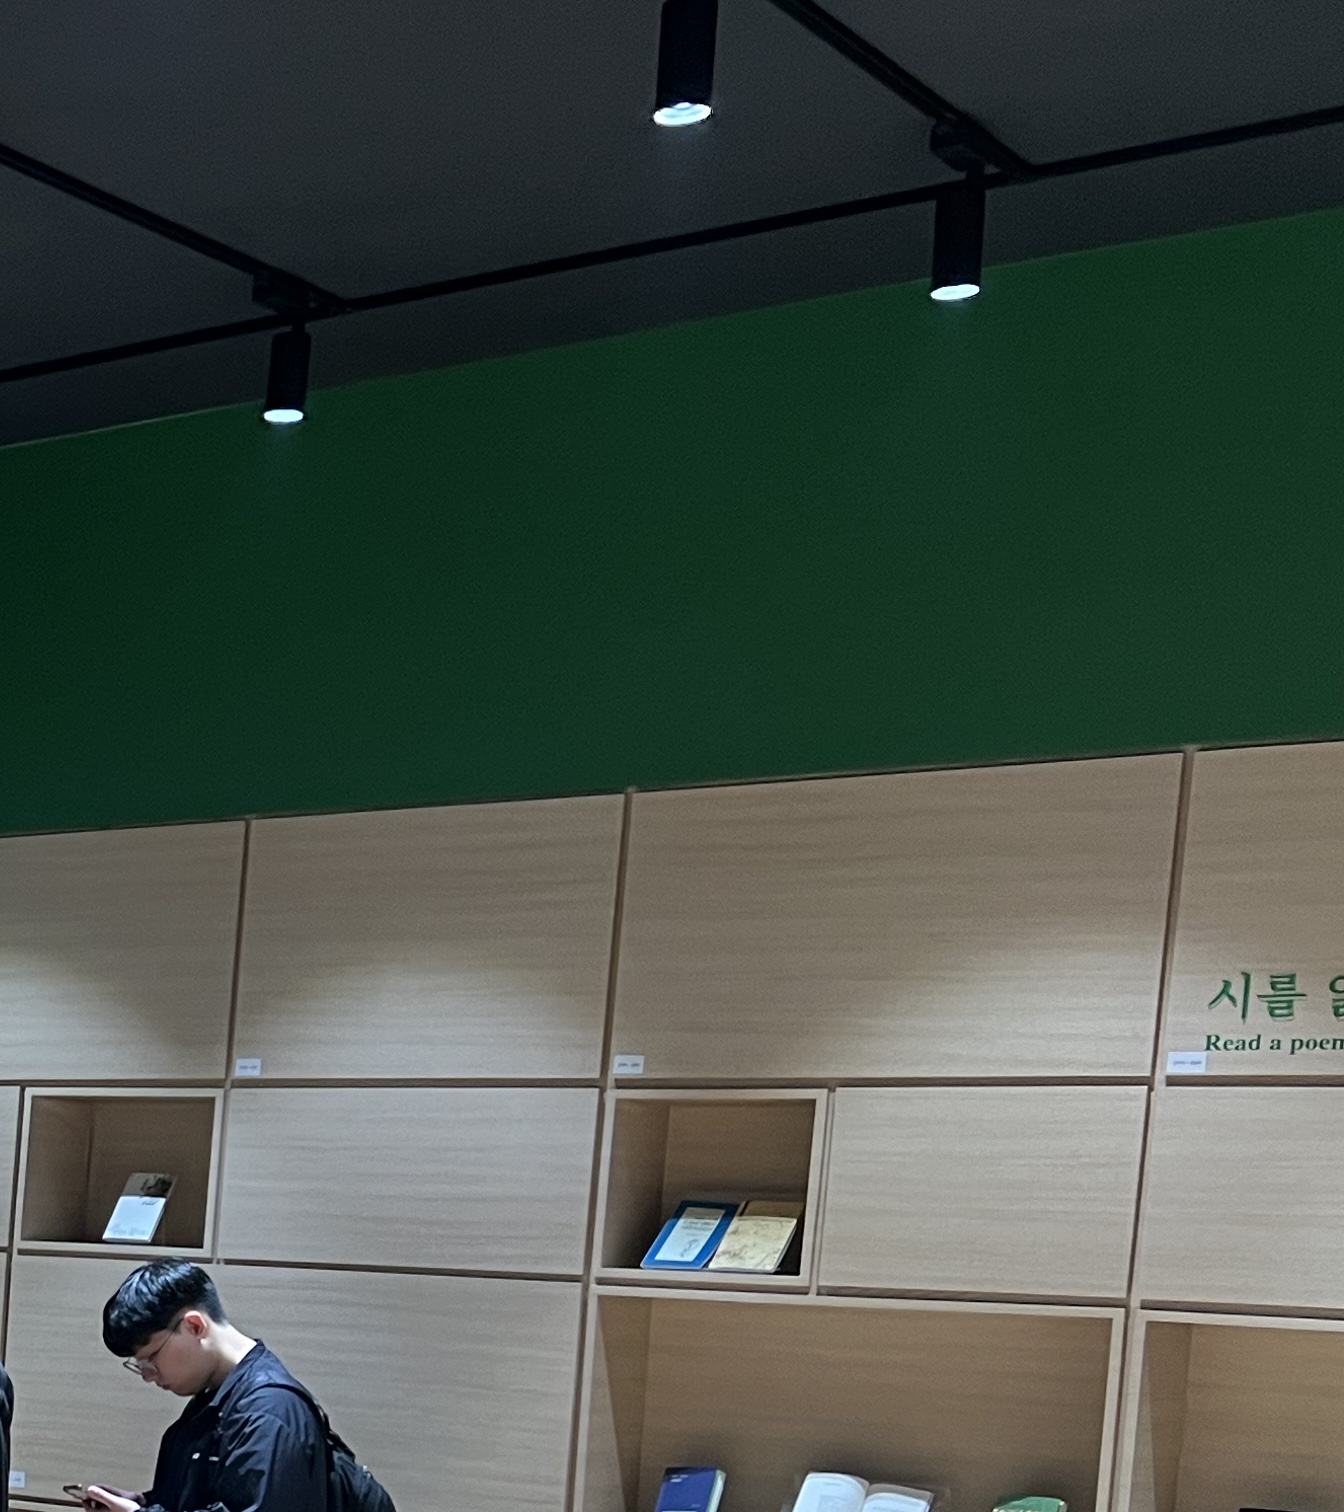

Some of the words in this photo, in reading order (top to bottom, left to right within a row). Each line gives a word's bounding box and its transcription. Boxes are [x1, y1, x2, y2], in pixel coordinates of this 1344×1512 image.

[1207, 970, 1308, 1024] 시를
[1204, 1033, 1262, 1052] Read
[1269, 1037, 1282, 1051] a
